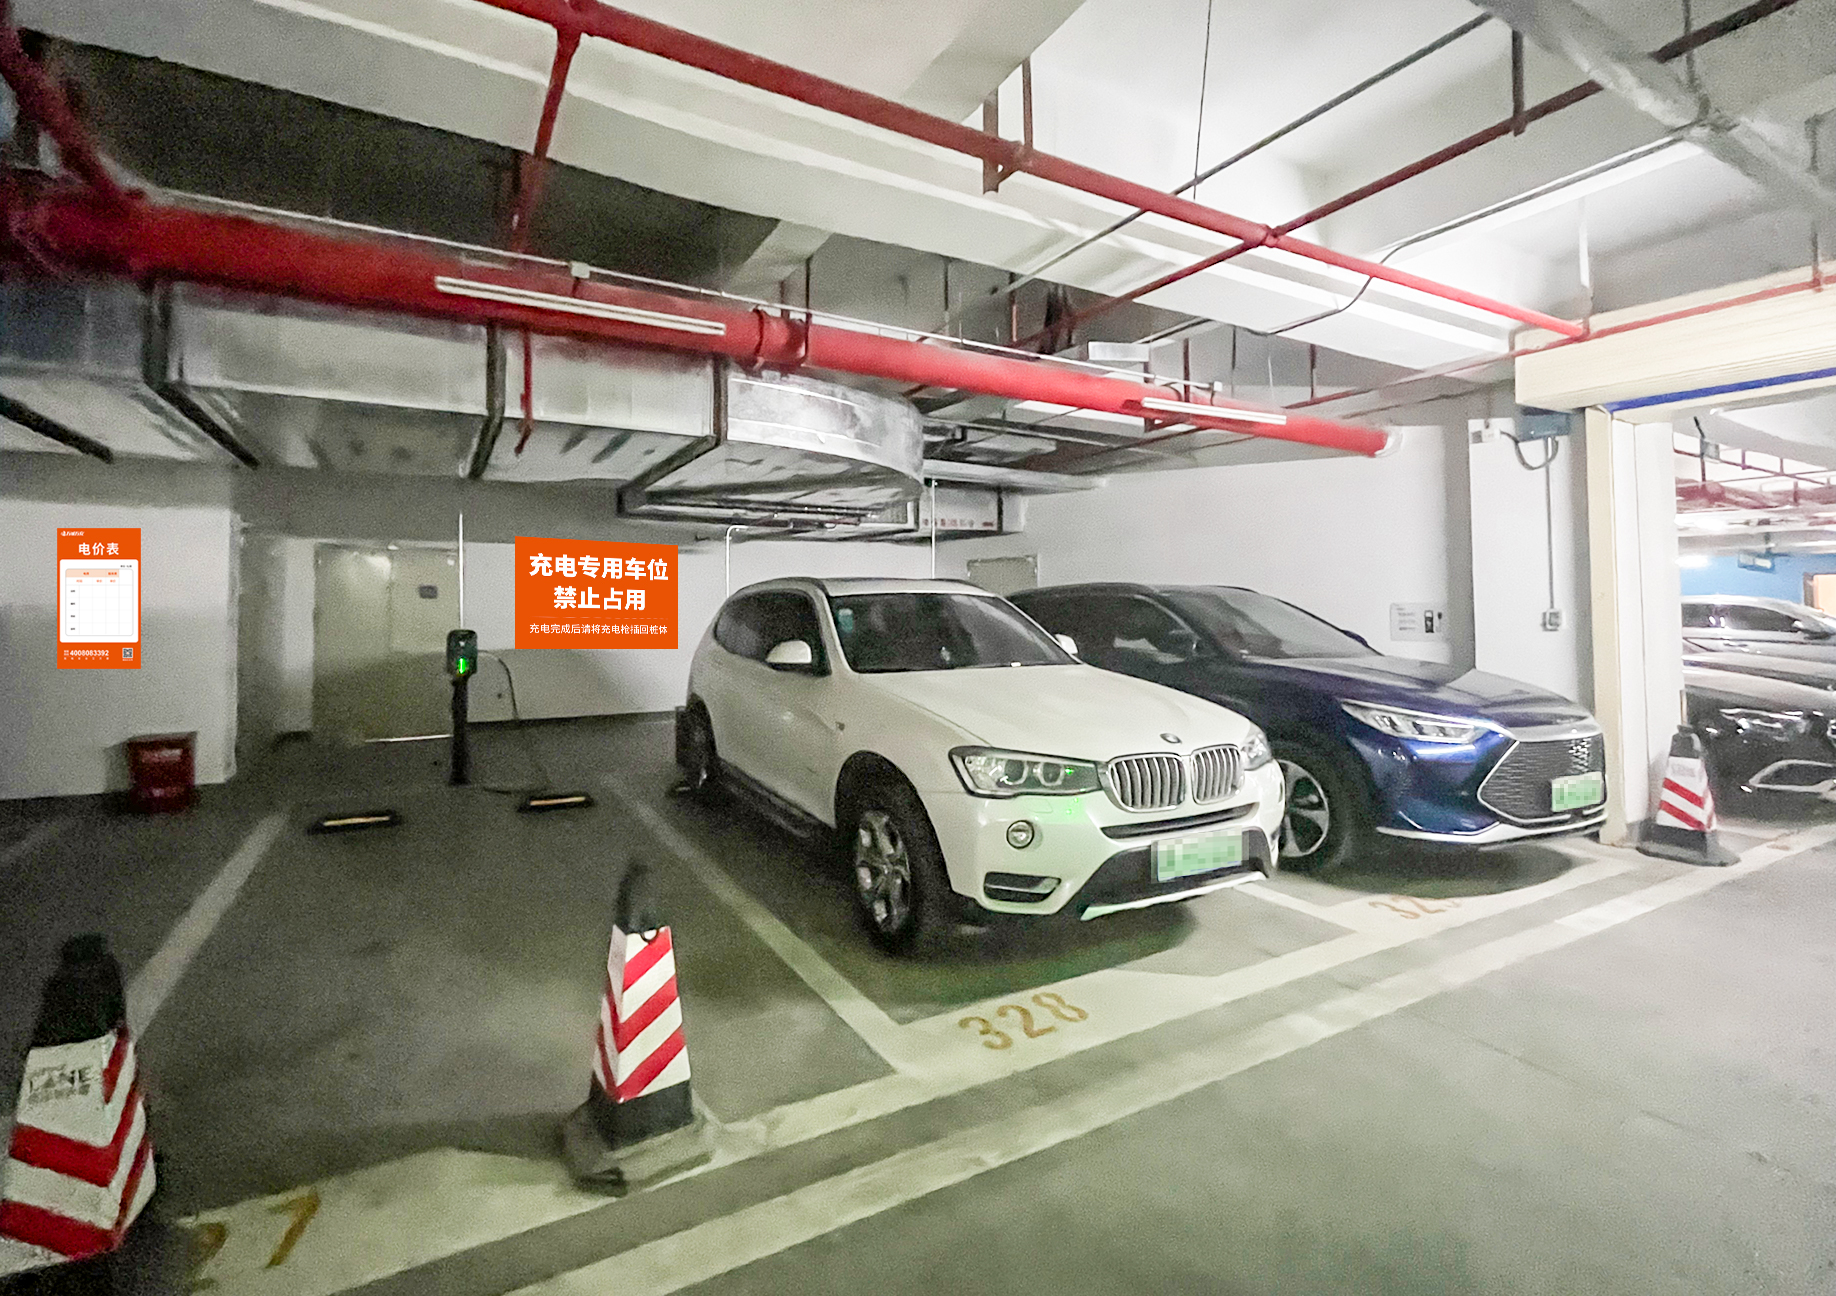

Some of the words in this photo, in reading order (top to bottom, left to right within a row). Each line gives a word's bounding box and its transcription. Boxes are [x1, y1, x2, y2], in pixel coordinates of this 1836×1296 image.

[79, 542, 119, 556] 电价表
[529, 553, 669, 581] 充电专用车位
[553, 586, 646, 611] 禁止占用
[529, 623, 668, 635] 充电完成后请将充电枪插回桩体
[1368, 894, 1462, 920] 32
[958, 992, 1089, 1051] 328
